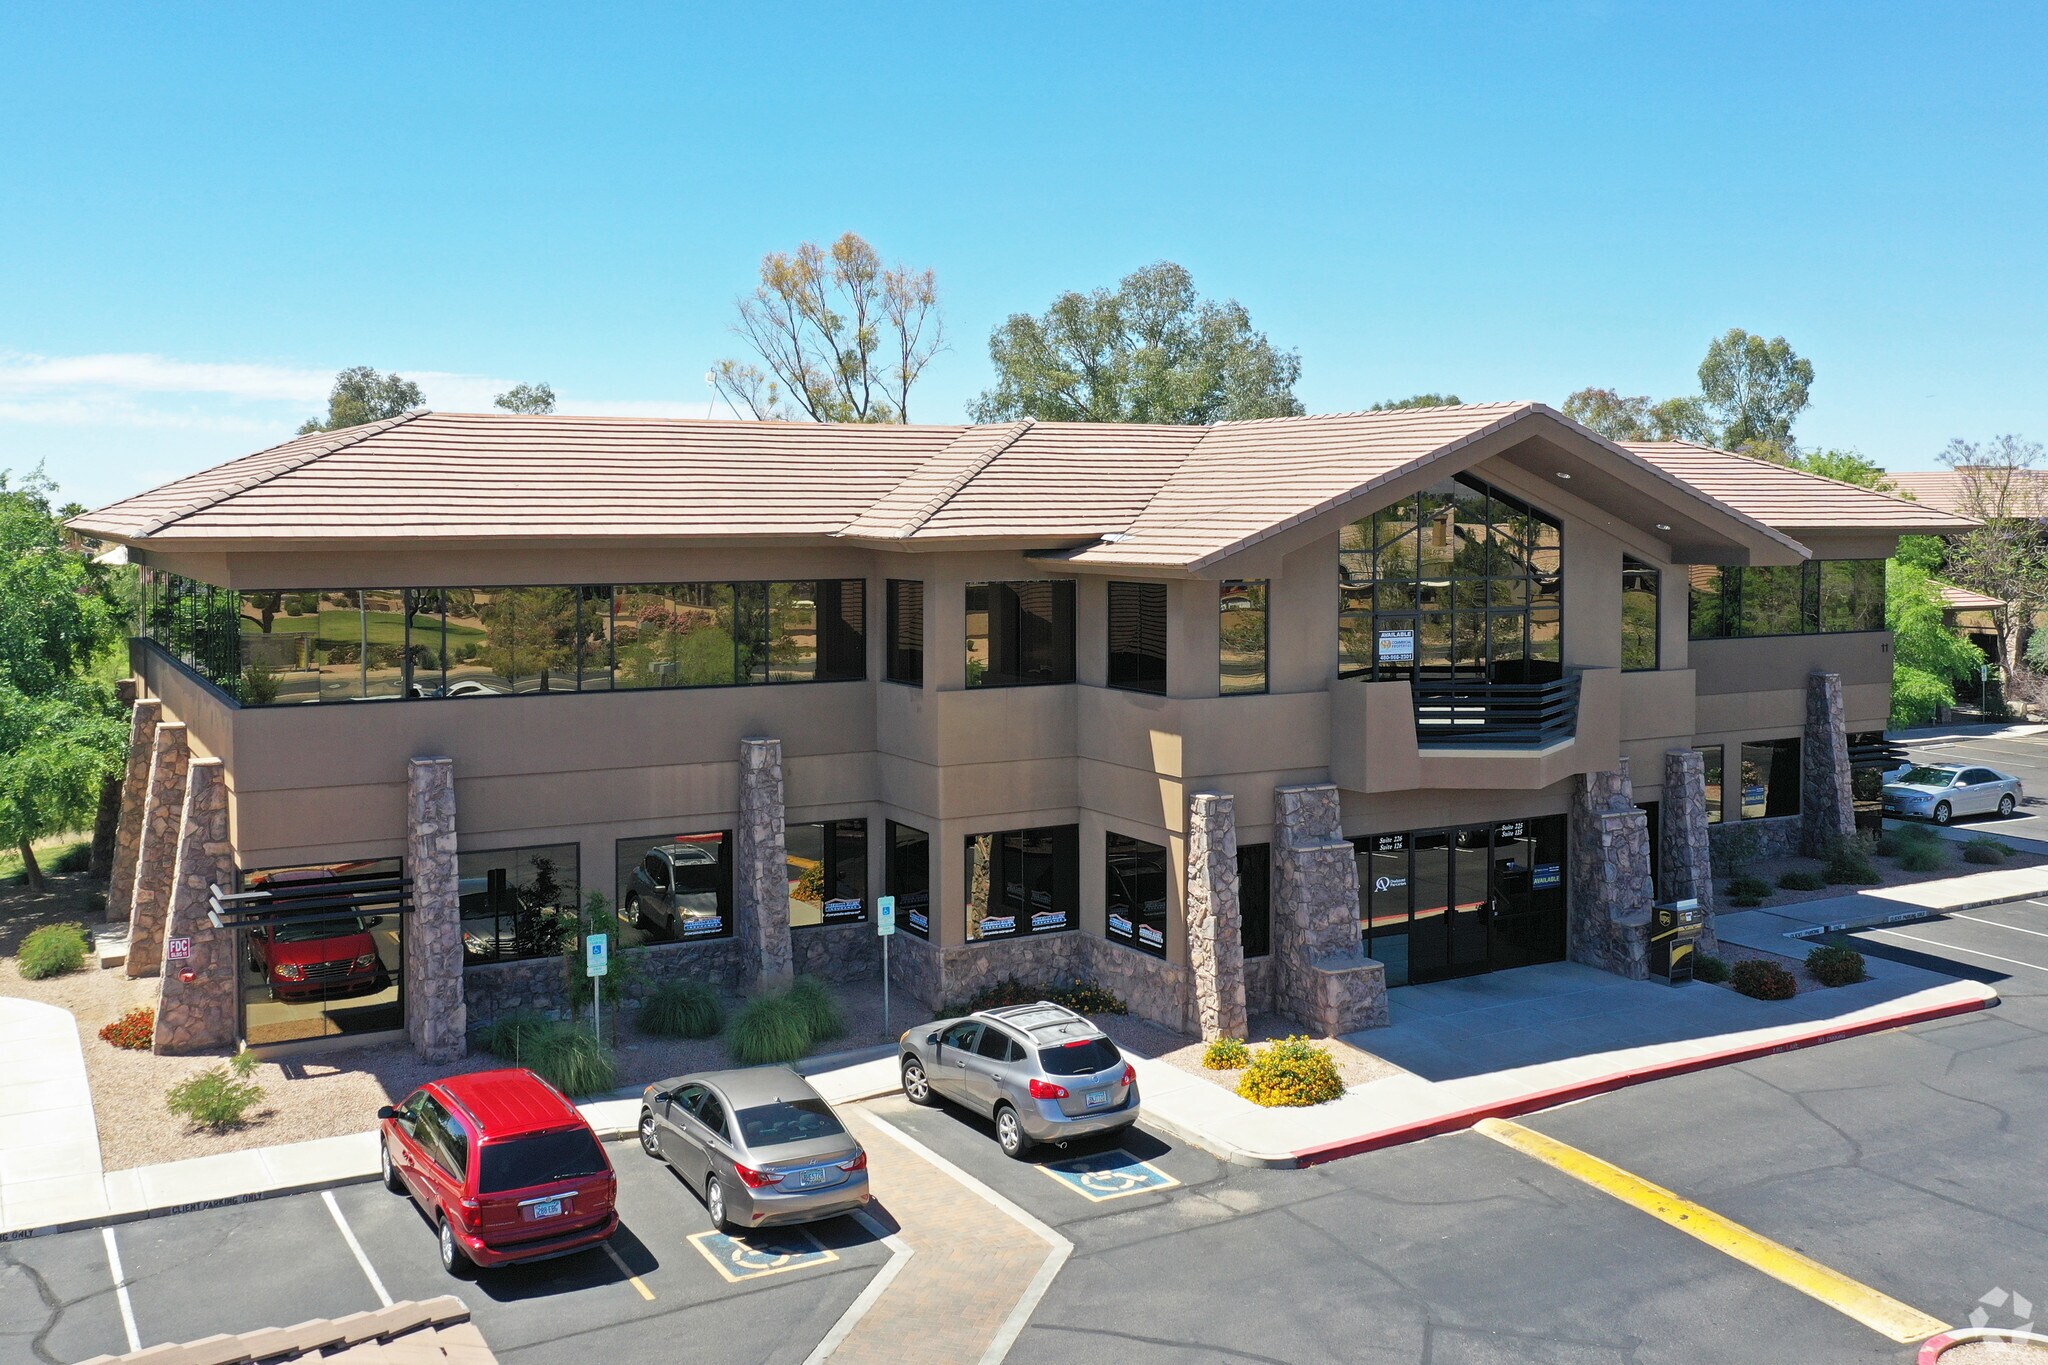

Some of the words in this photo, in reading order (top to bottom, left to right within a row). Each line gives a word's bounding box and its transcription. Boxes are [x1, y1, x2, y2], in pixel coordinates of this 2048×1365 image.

[1880, 642, 1888, 652] 11
[1379, 836, 1393, 844] Suite
[1533, 876, 1560, 884] AVAILABLE
[170, 940, 188, 952] FDC
[172, 1202, 201, 1214] CLIENT
[203, 1197, 238, 1209] PARKING
[242, 1193, 263, 1203] ONLY
[12, 1229, 34, 1239] ONLY
